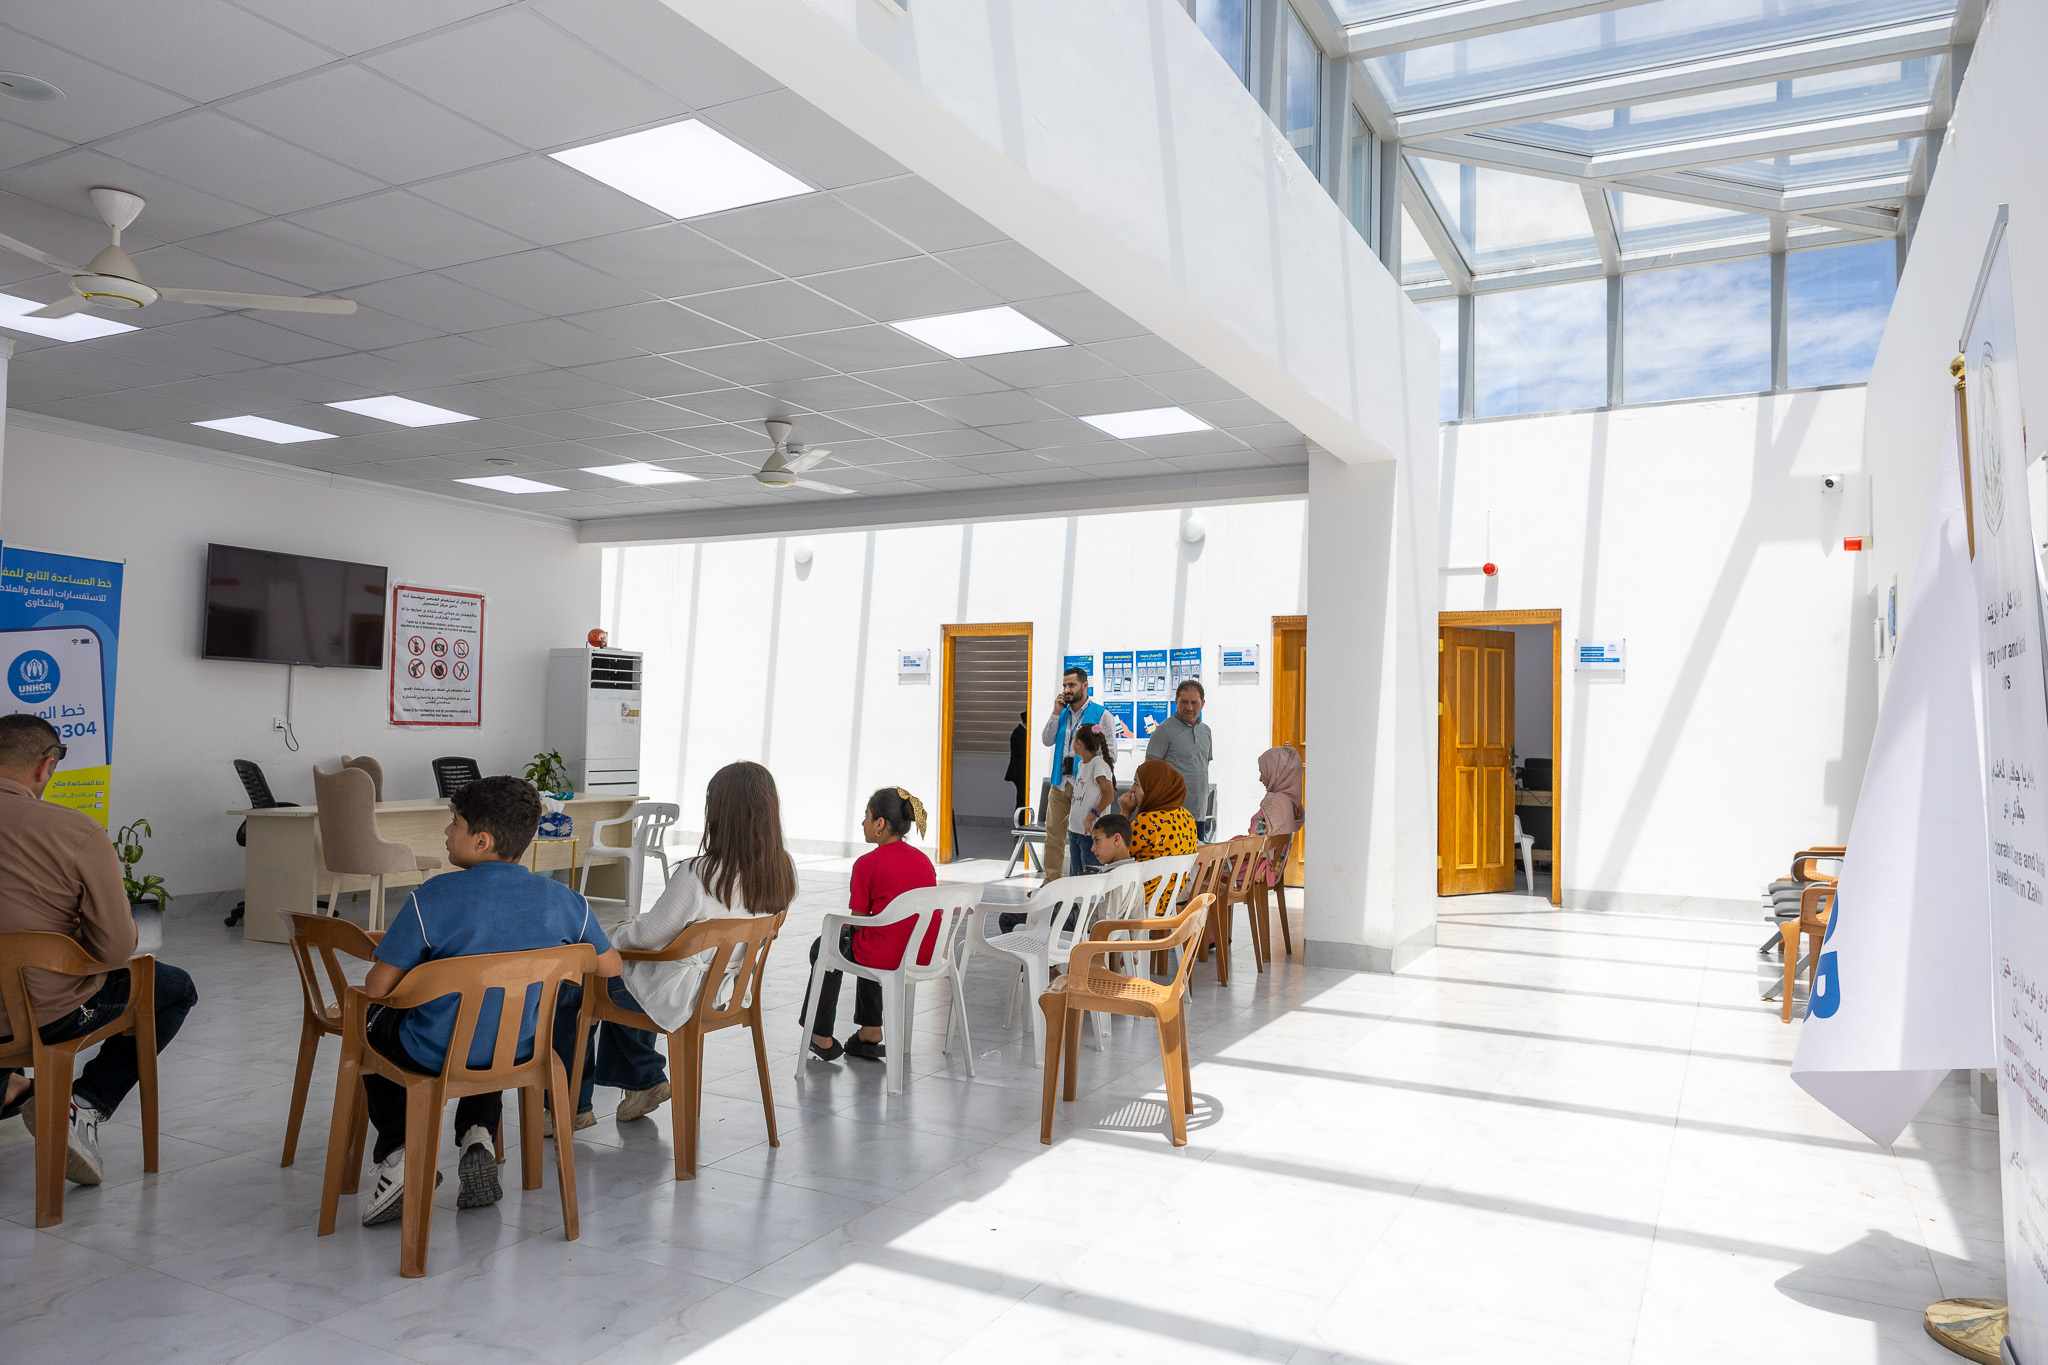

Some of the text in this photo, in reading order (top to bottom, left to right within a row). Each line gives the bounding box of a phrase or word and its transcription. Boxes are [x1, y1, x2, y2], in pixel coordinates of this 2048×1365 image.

[2, 567, 112, 588] خط المساعدة التابع للمف
[30, 587, 54, 597] العامة
[55, 590, 107, 603] للاستفسارات
[19, 682, 52, 693] UNHCR
[61, 704, 85, 718] خط
